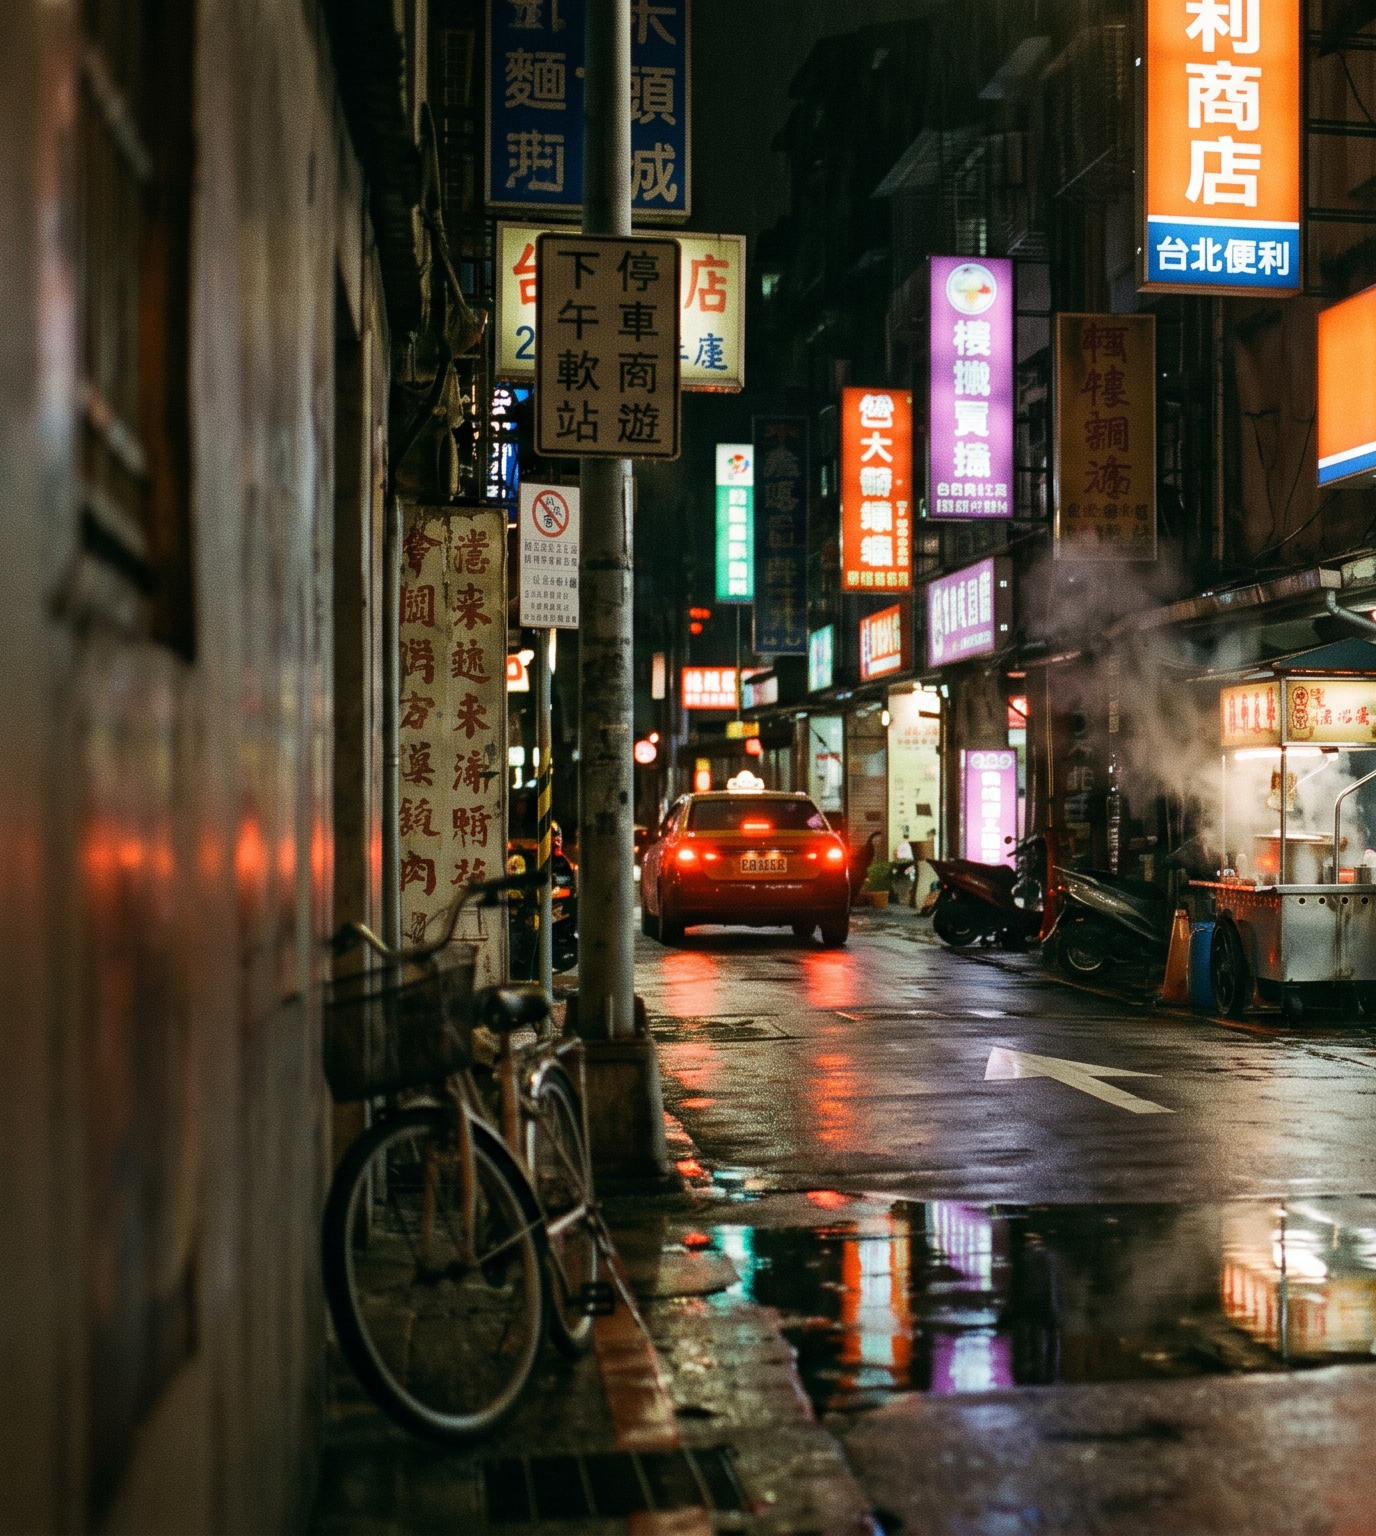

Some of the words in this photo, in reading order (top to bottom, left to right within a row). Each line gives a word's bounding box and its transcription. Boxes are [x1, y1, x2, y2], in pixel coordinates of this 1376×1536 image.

[1184, 0, 1263, 208] 利商店
[1156, 236, 1290, 276] 台北便利
